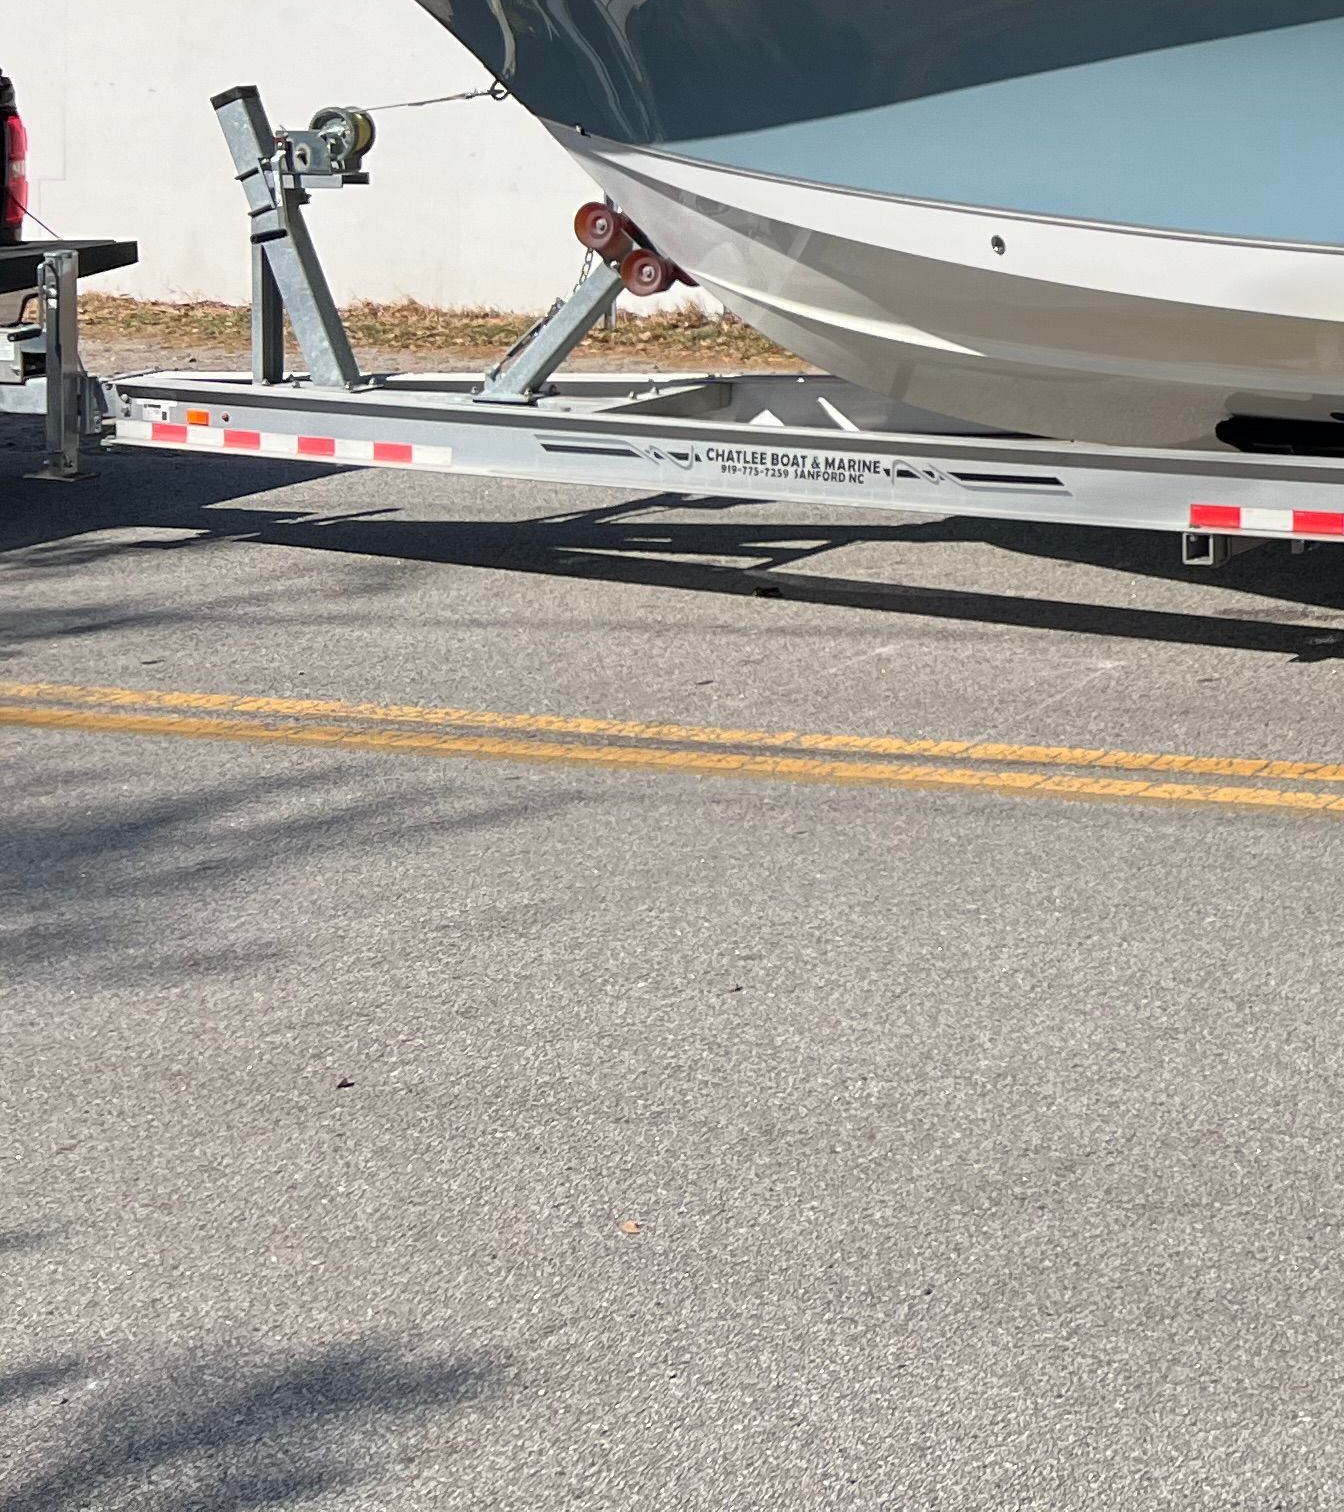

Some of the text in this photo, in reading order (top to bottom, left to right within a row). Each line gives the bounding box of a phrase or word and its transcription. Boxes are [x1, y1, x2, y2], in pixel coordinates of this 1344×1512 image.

[706, 447, 881, 474] CHATLEE BOAT & MARINE
[721, 464, 864, 484] 919-775-7259 SANFORD NC
